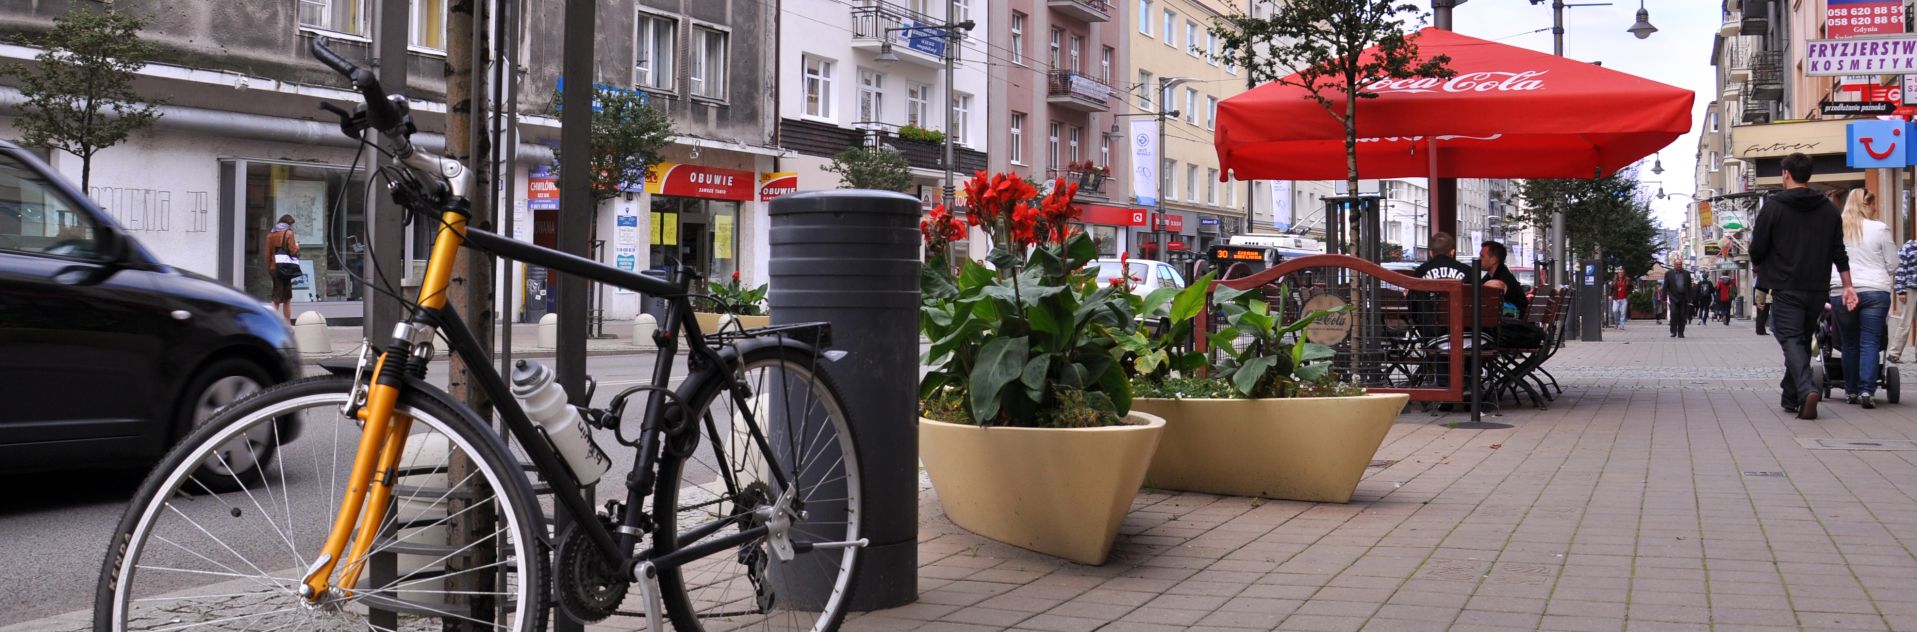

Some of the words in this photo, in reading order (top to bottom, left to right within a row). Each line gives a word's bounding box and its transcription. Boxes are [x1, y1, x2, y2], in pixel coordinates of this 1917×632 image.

[1874, 6, 1887, 14] 88
[1891, 6, 1904, 14] 51
[1828, 18, 1848, 26] 058
[1851, 17, 1871, 25] 620
[1874, 16, 1887, 24] 88
[1891, 15, 1904, 23] 61
[1809, 40, 1916, 58] FRYZJERSTW
[1811, 57, 1914, 71] KOSMETYK
[1442, 69, 1549, 92] Cola
[1861, 104, 1886, 112] paznokci
[690, 172, 734, 186] OBUWIE
[763, 187, 796, 195] OBUWIE
[1217, 250, 1228, 258] 30
[109, 533, 131, 591] KENDA
